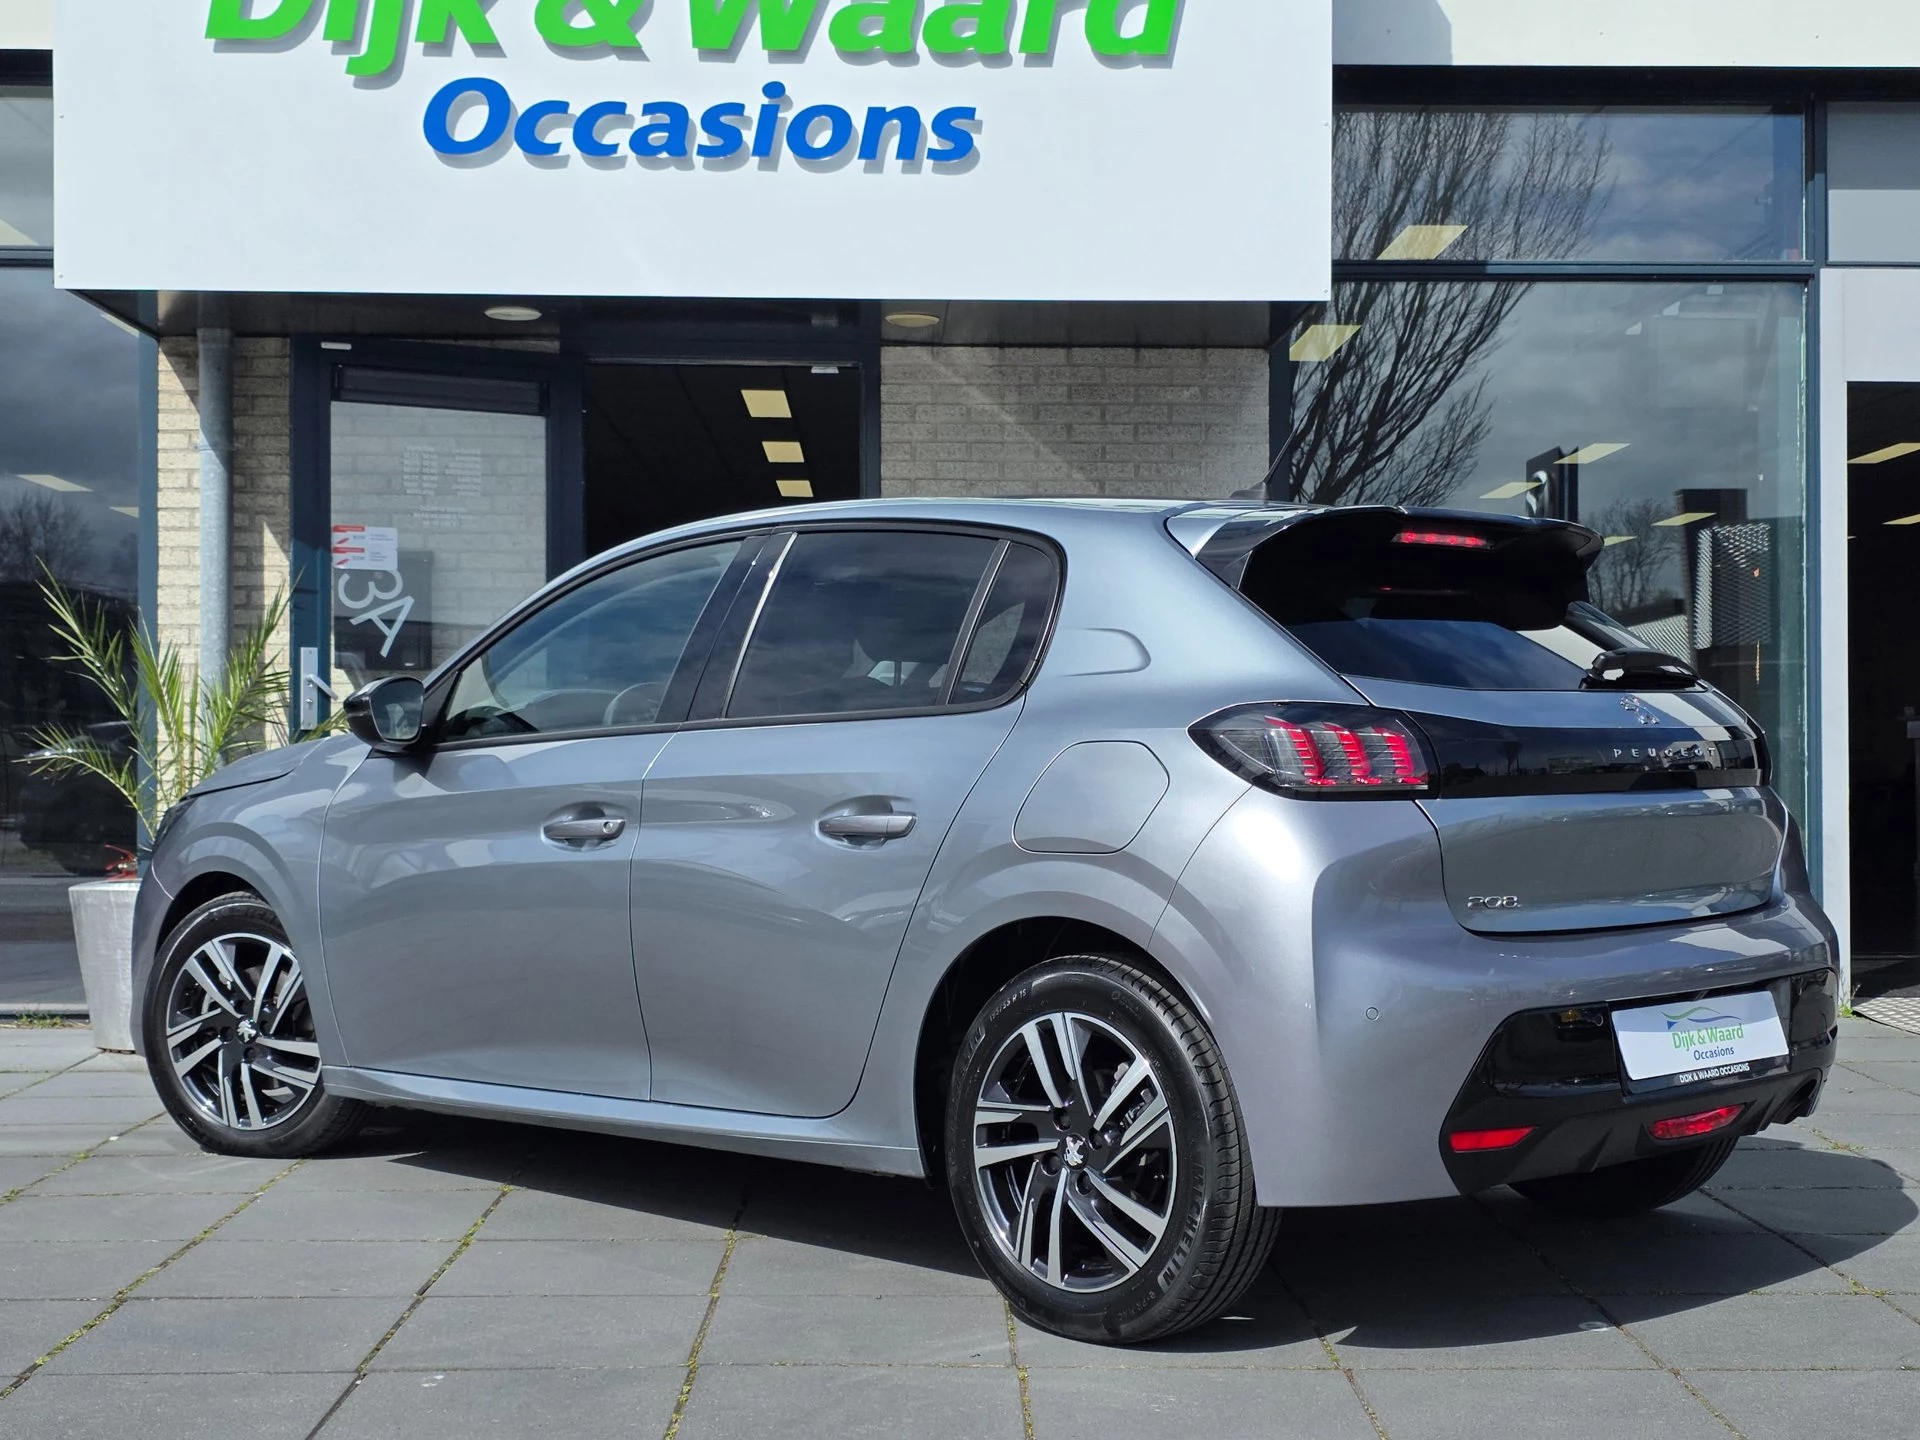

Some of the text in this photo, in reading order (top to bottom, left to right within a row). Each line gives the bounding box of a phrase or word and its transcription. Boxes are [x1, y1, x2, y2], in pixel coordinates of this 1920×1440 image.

[423, 77, 978, 162] Occasions
[1612, 746, 1717, 759] PEUGEOT
[1467, 894, 1519, 910] 208
[1672, 1023, 1744, 1051] Dijk & Waard
[1693, 1046, 1735, 1061] Occasions
[1698, 1068, 1720, 1080] WAARD
[1720, 1062, 1750, 1075] OCCASIONS
